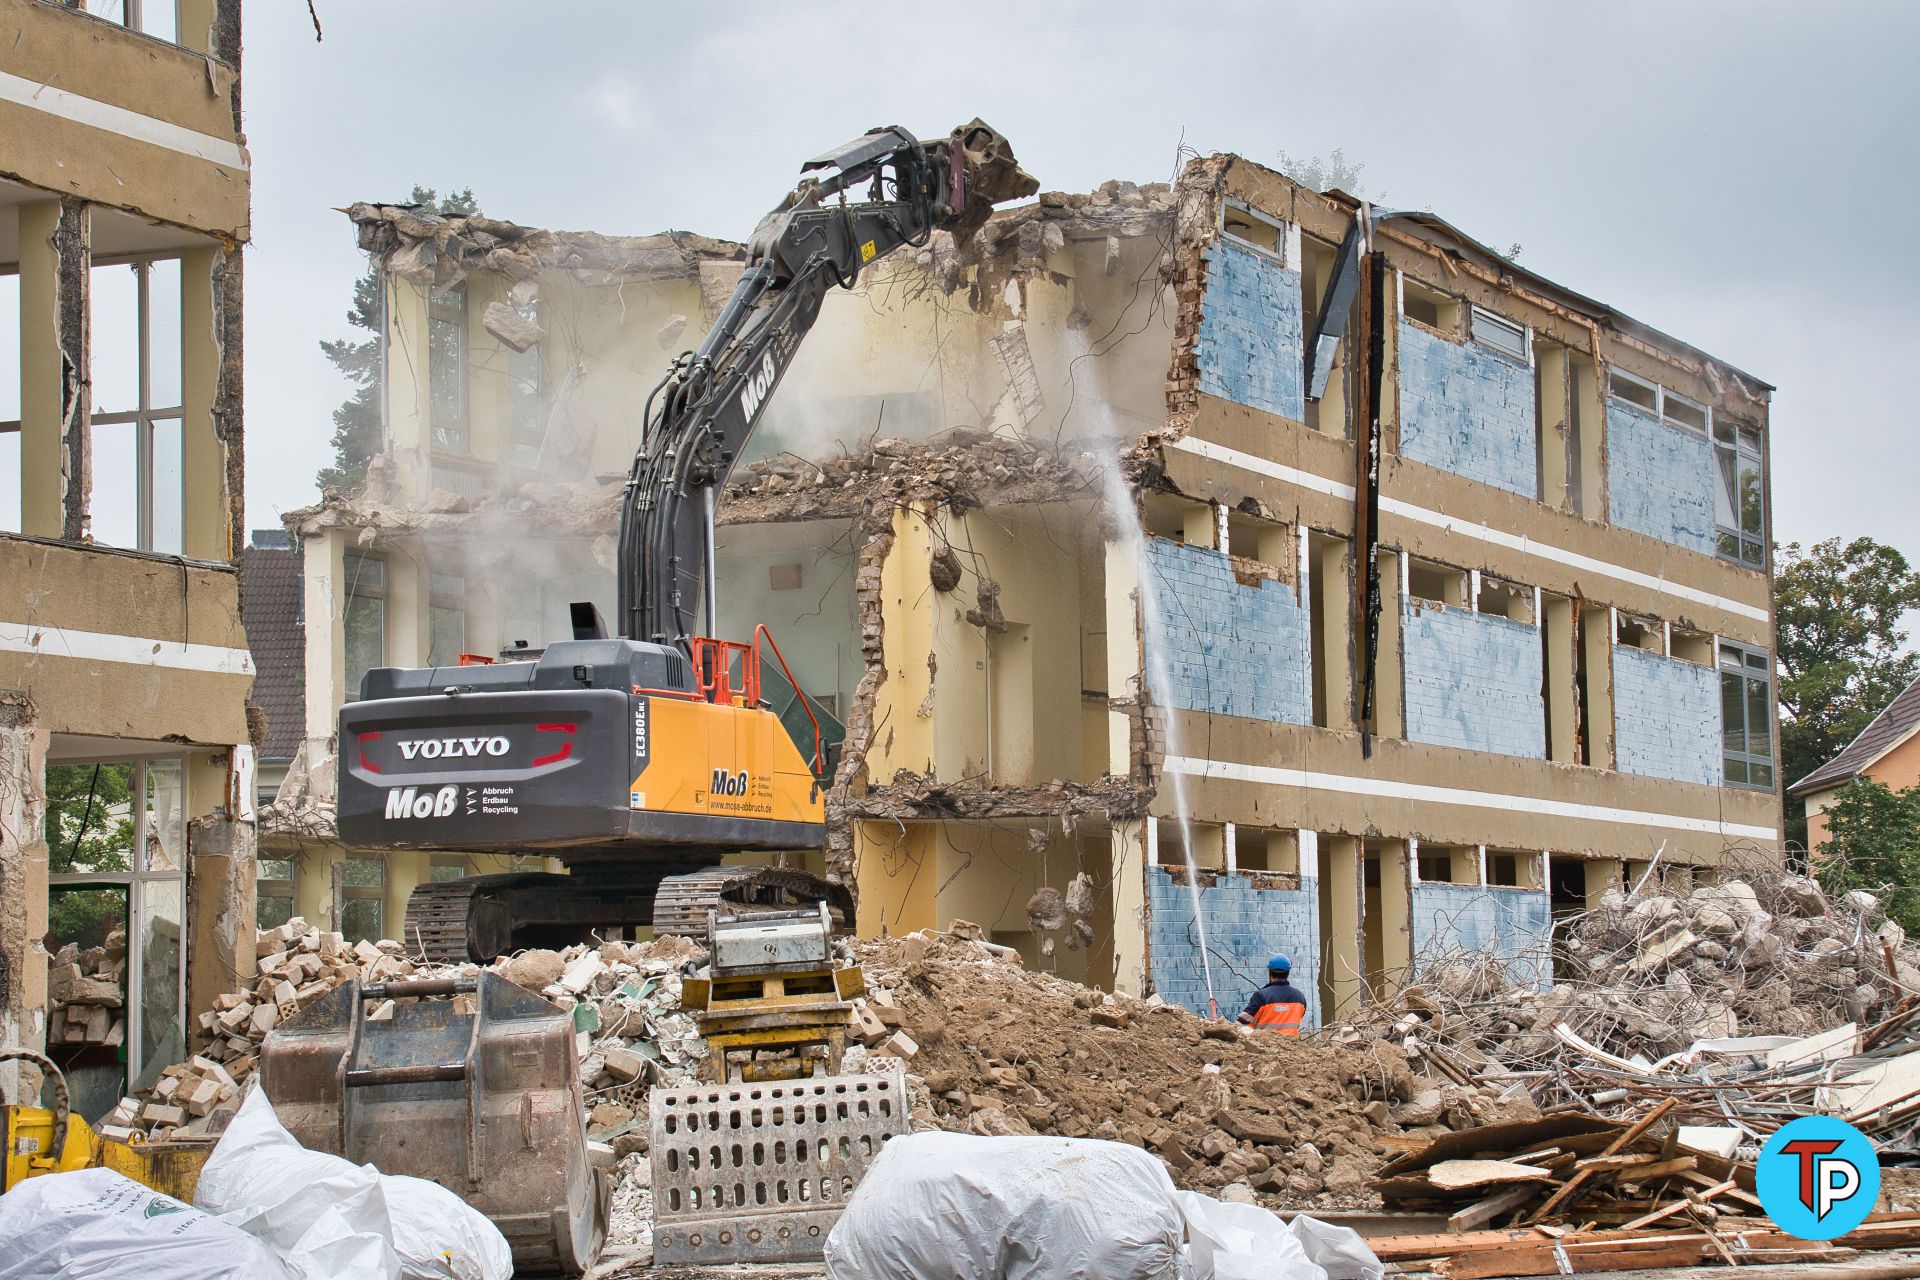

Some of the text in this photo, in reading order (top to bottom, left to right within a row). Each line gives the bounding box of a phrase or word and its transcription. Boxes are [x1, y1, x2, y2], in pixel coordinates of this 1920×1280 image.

[741, 350, 775, 424] Moß
[397, 736, 511, 760] VOLVO
[482, 787, 513, 795] Abbruch
[710, 768, 748, 797] Moß
[385, 785, 459, 819] Moß
[482, 796, 508, 805] Erdbau
[710, 801, 772, 814] www.moss-abbruch.de
[482, 805, 518, 815] Recycling
